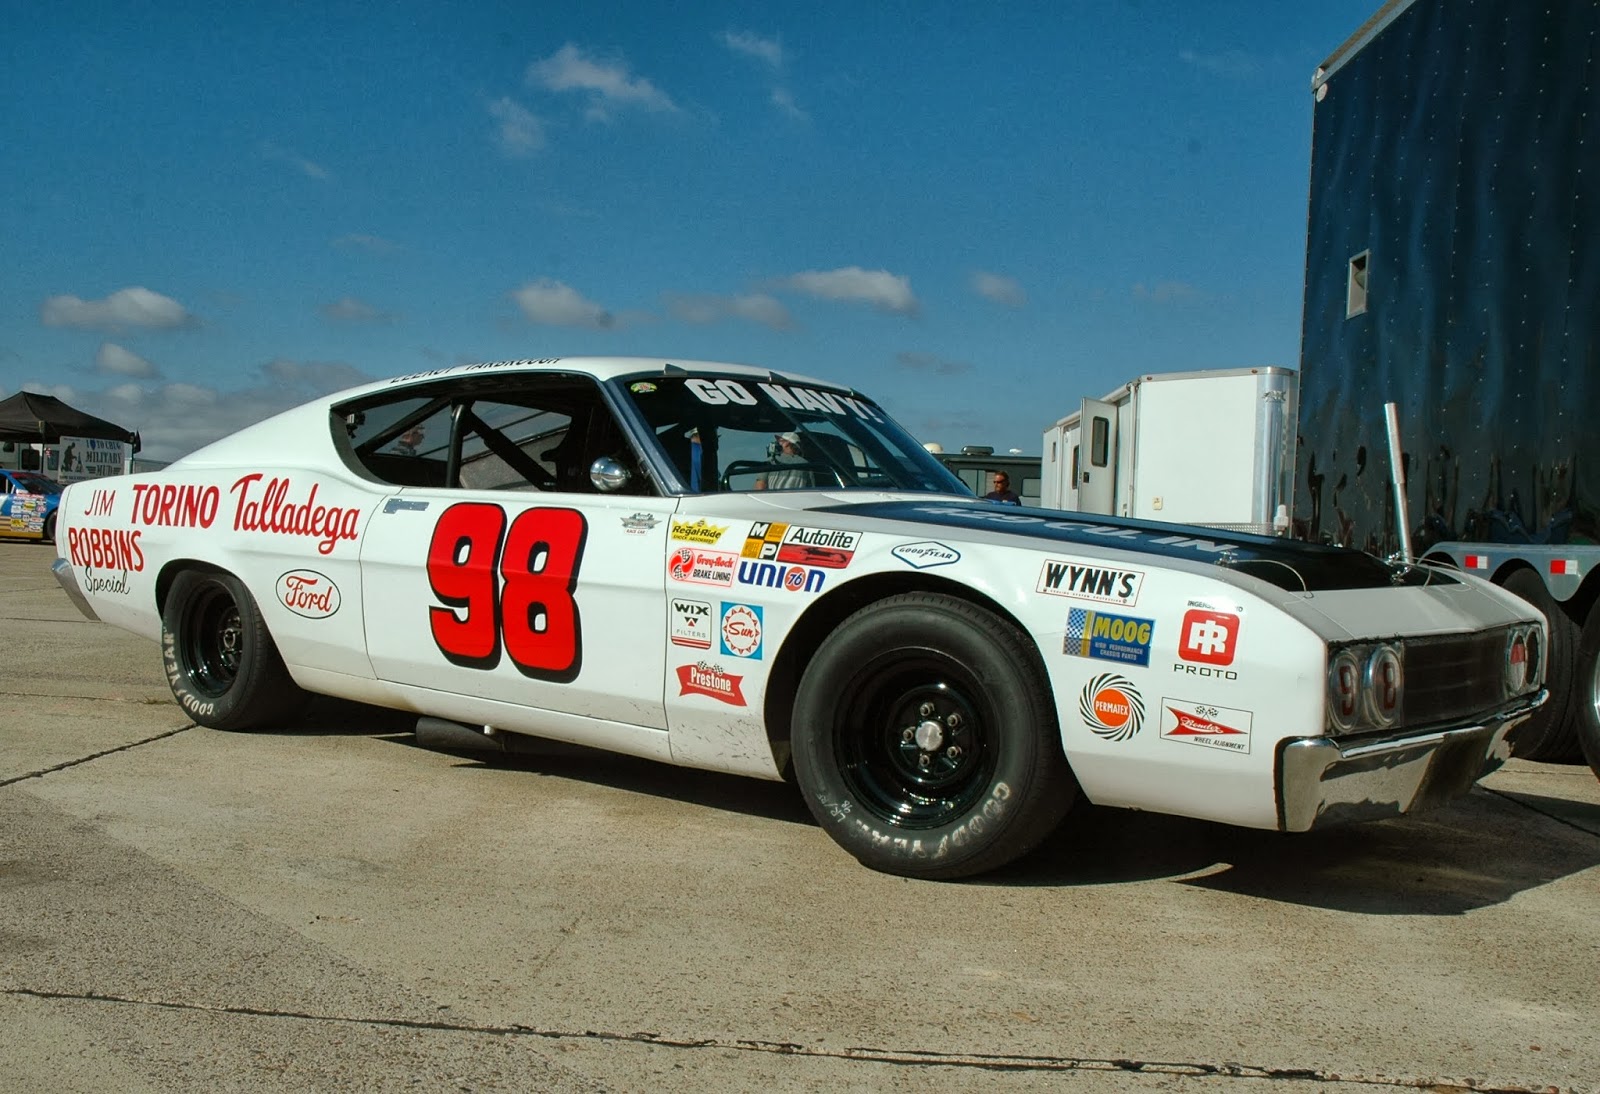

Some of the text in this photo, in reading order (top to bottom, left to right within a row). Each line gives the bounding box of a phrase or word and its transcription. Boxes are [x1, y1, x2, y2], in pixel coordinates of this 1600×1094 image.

[684, 378, 884, 424] GO NAVY!
[86, 451, 121, 464] MILITARY
[84, 489, 116, 516] JIM
[131, 473, 361, 555] TORINO Talladega
[750, 522, 770, 538] M
[790, 528, 854, 548] Autolite
[68, 527, 144, 572] ROBBINS
[759, 543, 778, 559] P
[84, 564, 130, 595] Special
[692, 568, 732, 582] BRAKE LINING
[787, 573, 803, 586] 76
[1045, 562, 1136, 598] WYNN'S
[285, 575, 333, 612] Ford
[426, 502, 588, 684] 98
[674, 602, 710, 616] WIX
[676, 628, 706, 639] FILTERS
[728, 621, 754, 638] Sun
[1093, 616, 1151, 645] MOOG
[690, 666, 732, 692] Prestone
[1173, 663, 1238, 681] PROTO
[1095, 700, 1129, 716] PERMATEX
[1193, 736, 1246, 751] WHEEL ALIGNMENT
